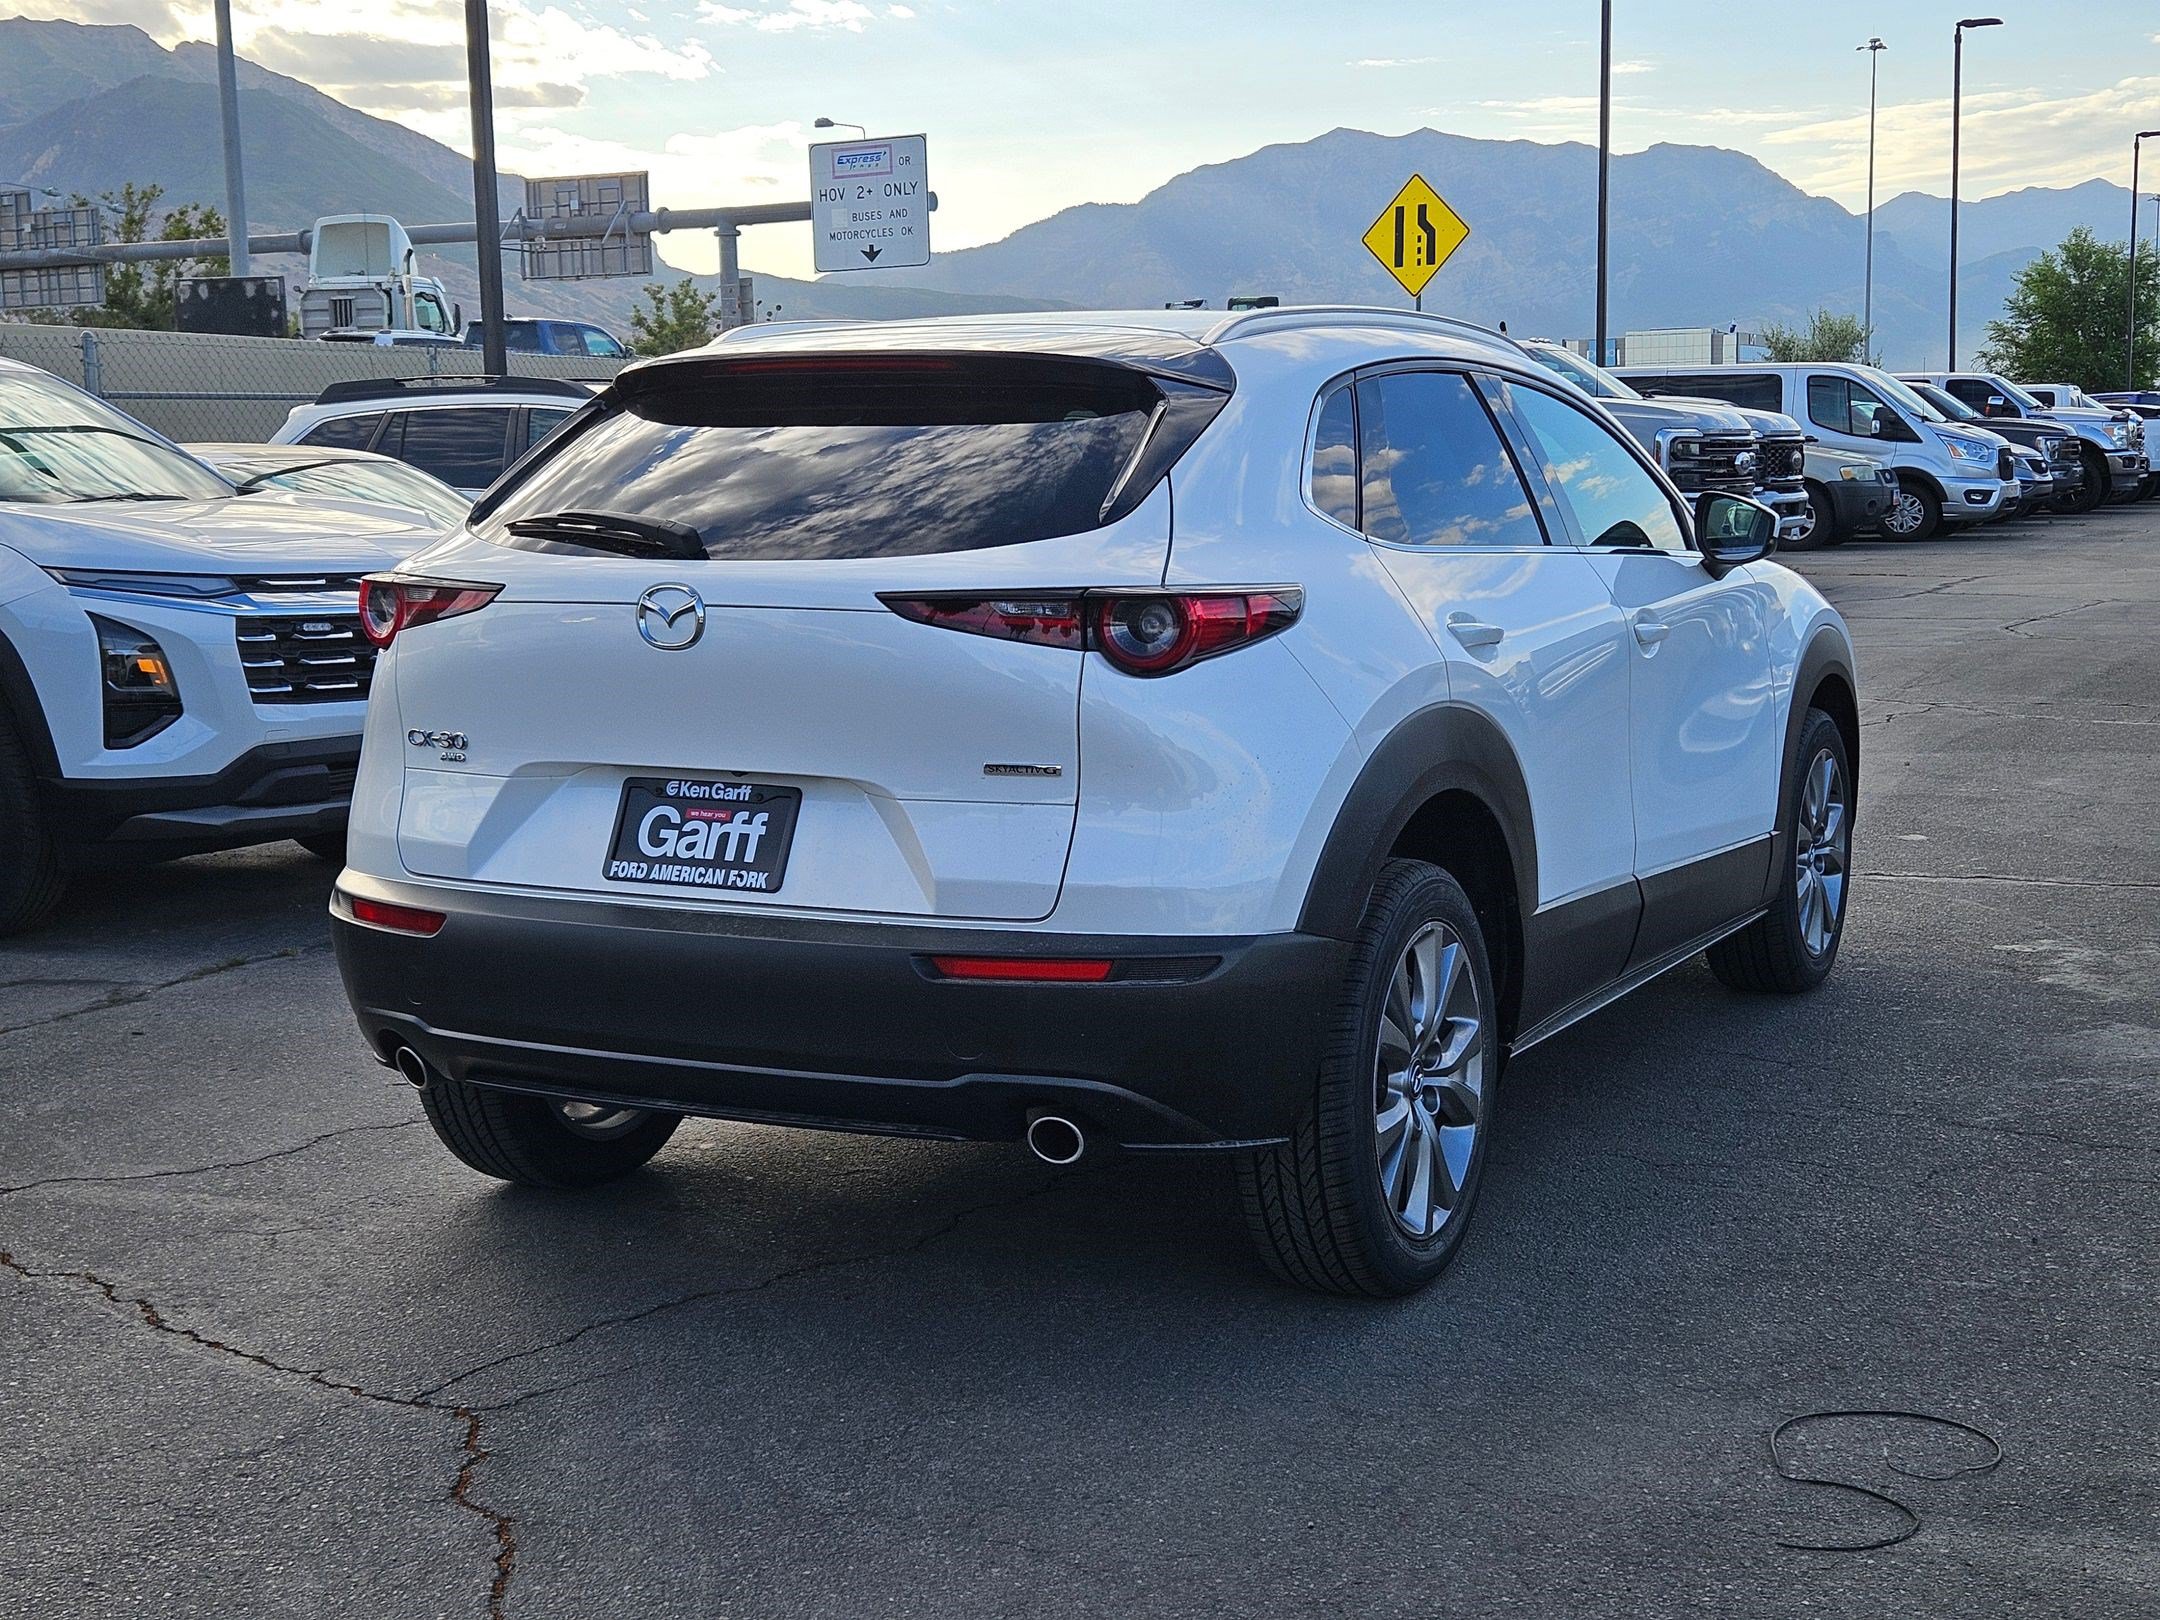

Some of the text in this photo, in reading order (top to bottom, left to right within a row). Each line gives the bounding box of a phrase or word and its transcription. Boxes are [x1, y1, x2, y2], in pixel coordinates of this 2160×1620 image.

[837, 152, 882, 170] Express
[898, 156, 911, 166] OR
[819, 181, 918, 202] HOV 2+ ONLY
[852, 208, 908, 222] BUSES AND
[829, 226, 913, 241] MOTORCYCLES OK
[407, 728, 468, 750] CX-30
[679, 780, 752, 801] Ken Garff
[638, 805, 769, 863] Garff
[609, 860, 769, 889] FORD AMERICAN FORK
